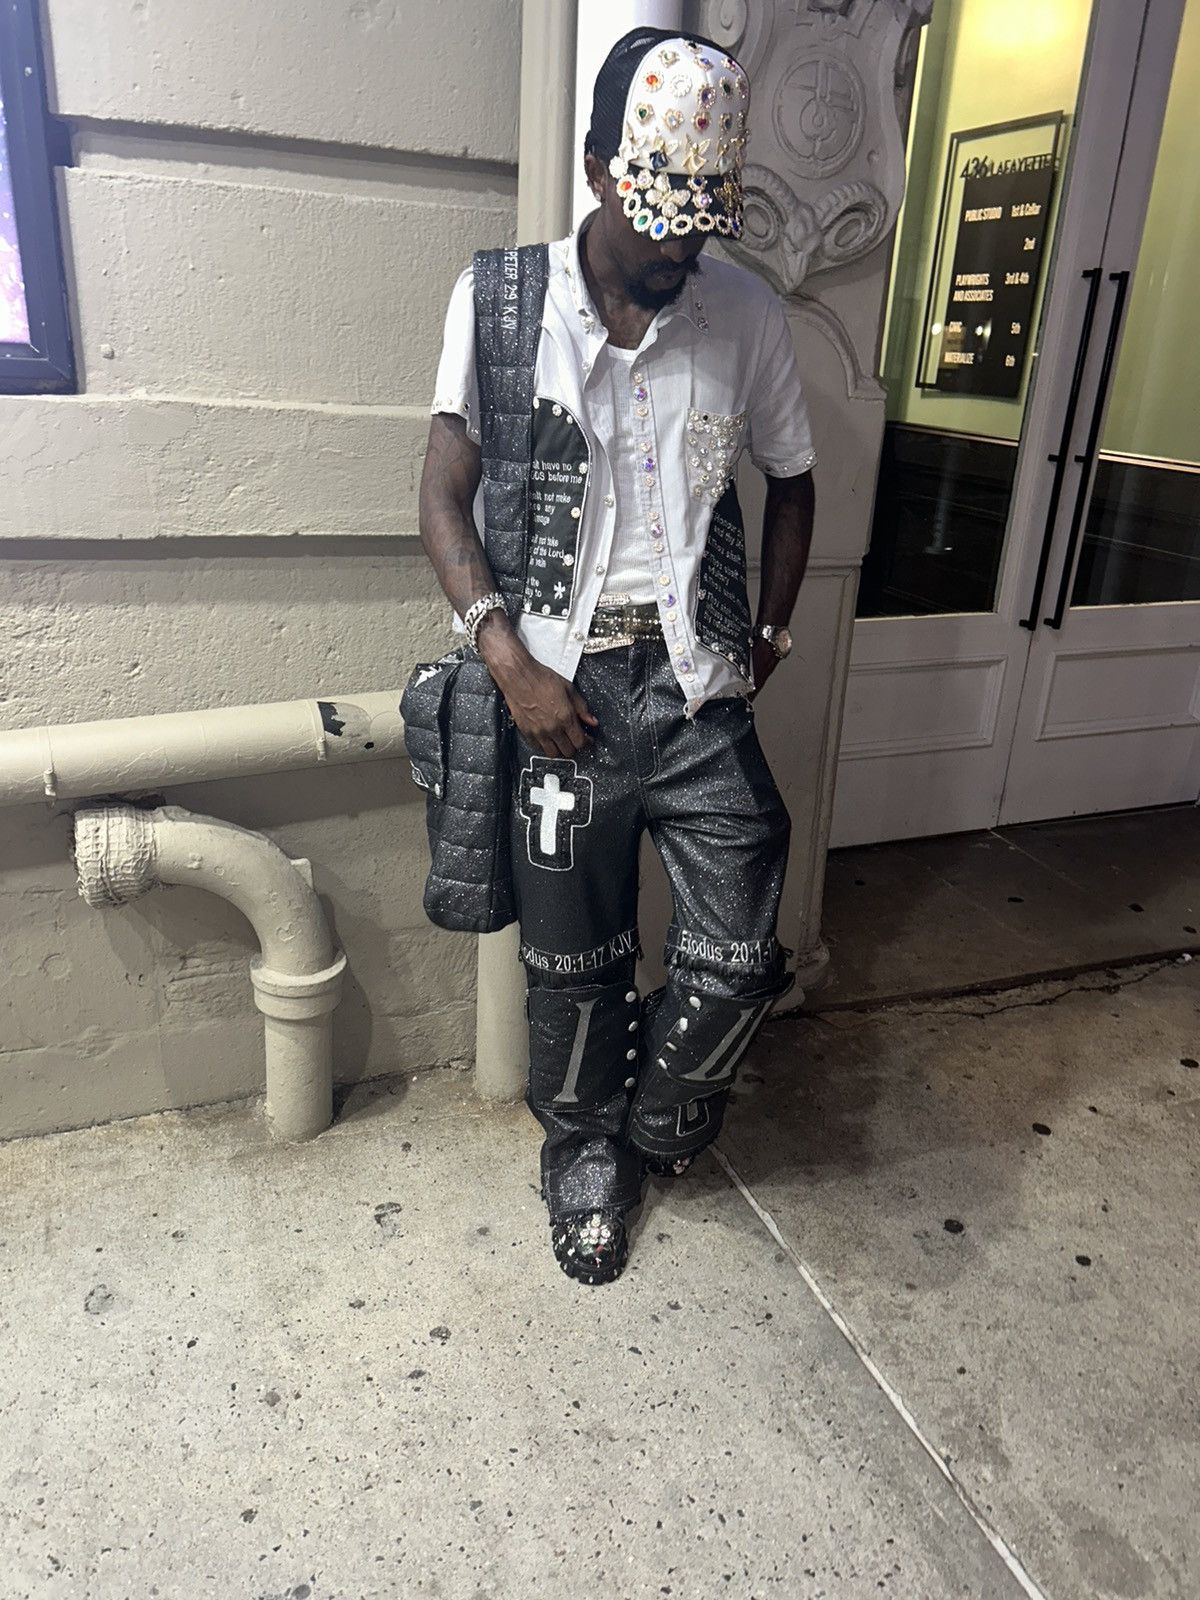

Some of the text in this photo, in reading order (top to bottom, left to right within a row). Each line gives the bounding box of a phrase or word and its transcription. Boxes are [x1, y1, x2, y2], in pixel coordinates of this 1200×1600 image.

[959, 155, 988, 179] 436
[541, 460, 560, 471] have
[562, 463, 572, 472] no
[547, 470, 569, 483] before
[570, 474, 583, 484] me
[608, 931, 633, 961] KJV
